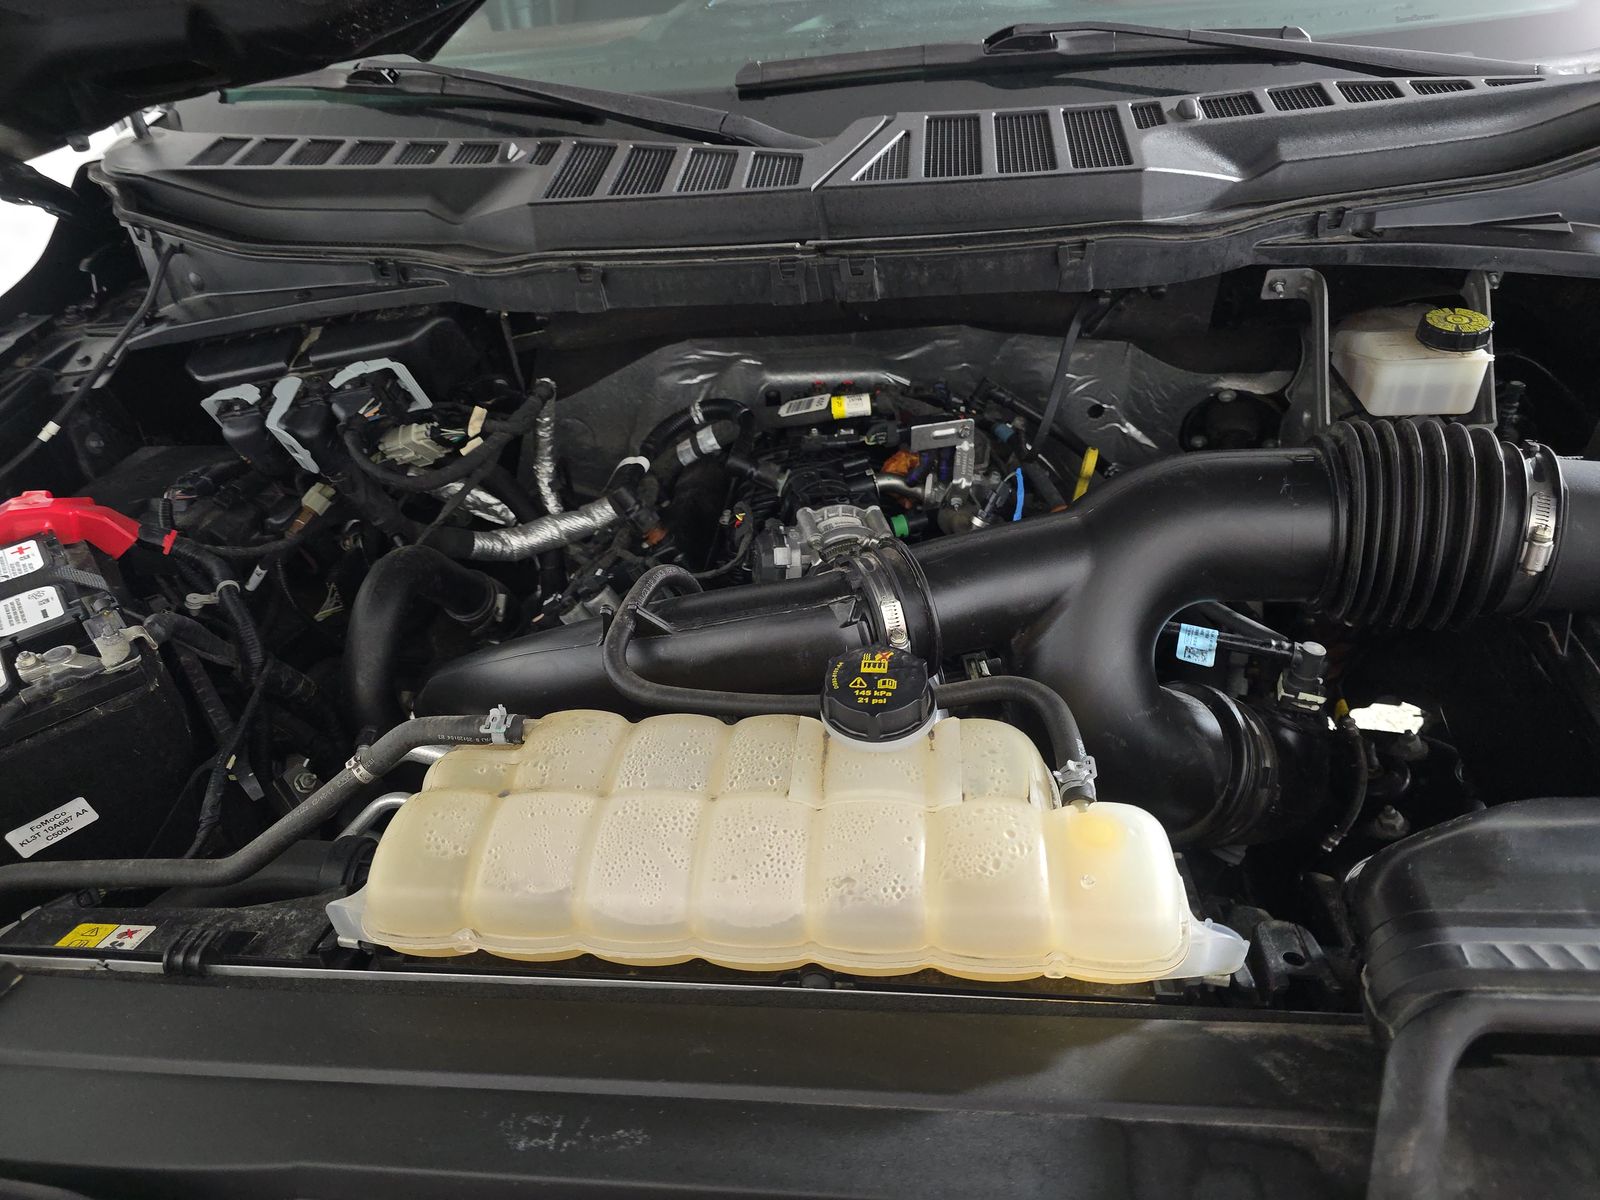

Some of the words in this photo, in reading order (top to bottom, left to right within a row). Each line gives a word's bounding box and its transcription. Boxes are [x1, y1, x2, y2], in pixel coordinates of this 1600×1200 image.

[19, 831, 42, 847] KL3T
[75, 808, 89, 818] AA
[29, 811, 67, 832] FoMoCo
[45, 825, 74, 842] C500L
